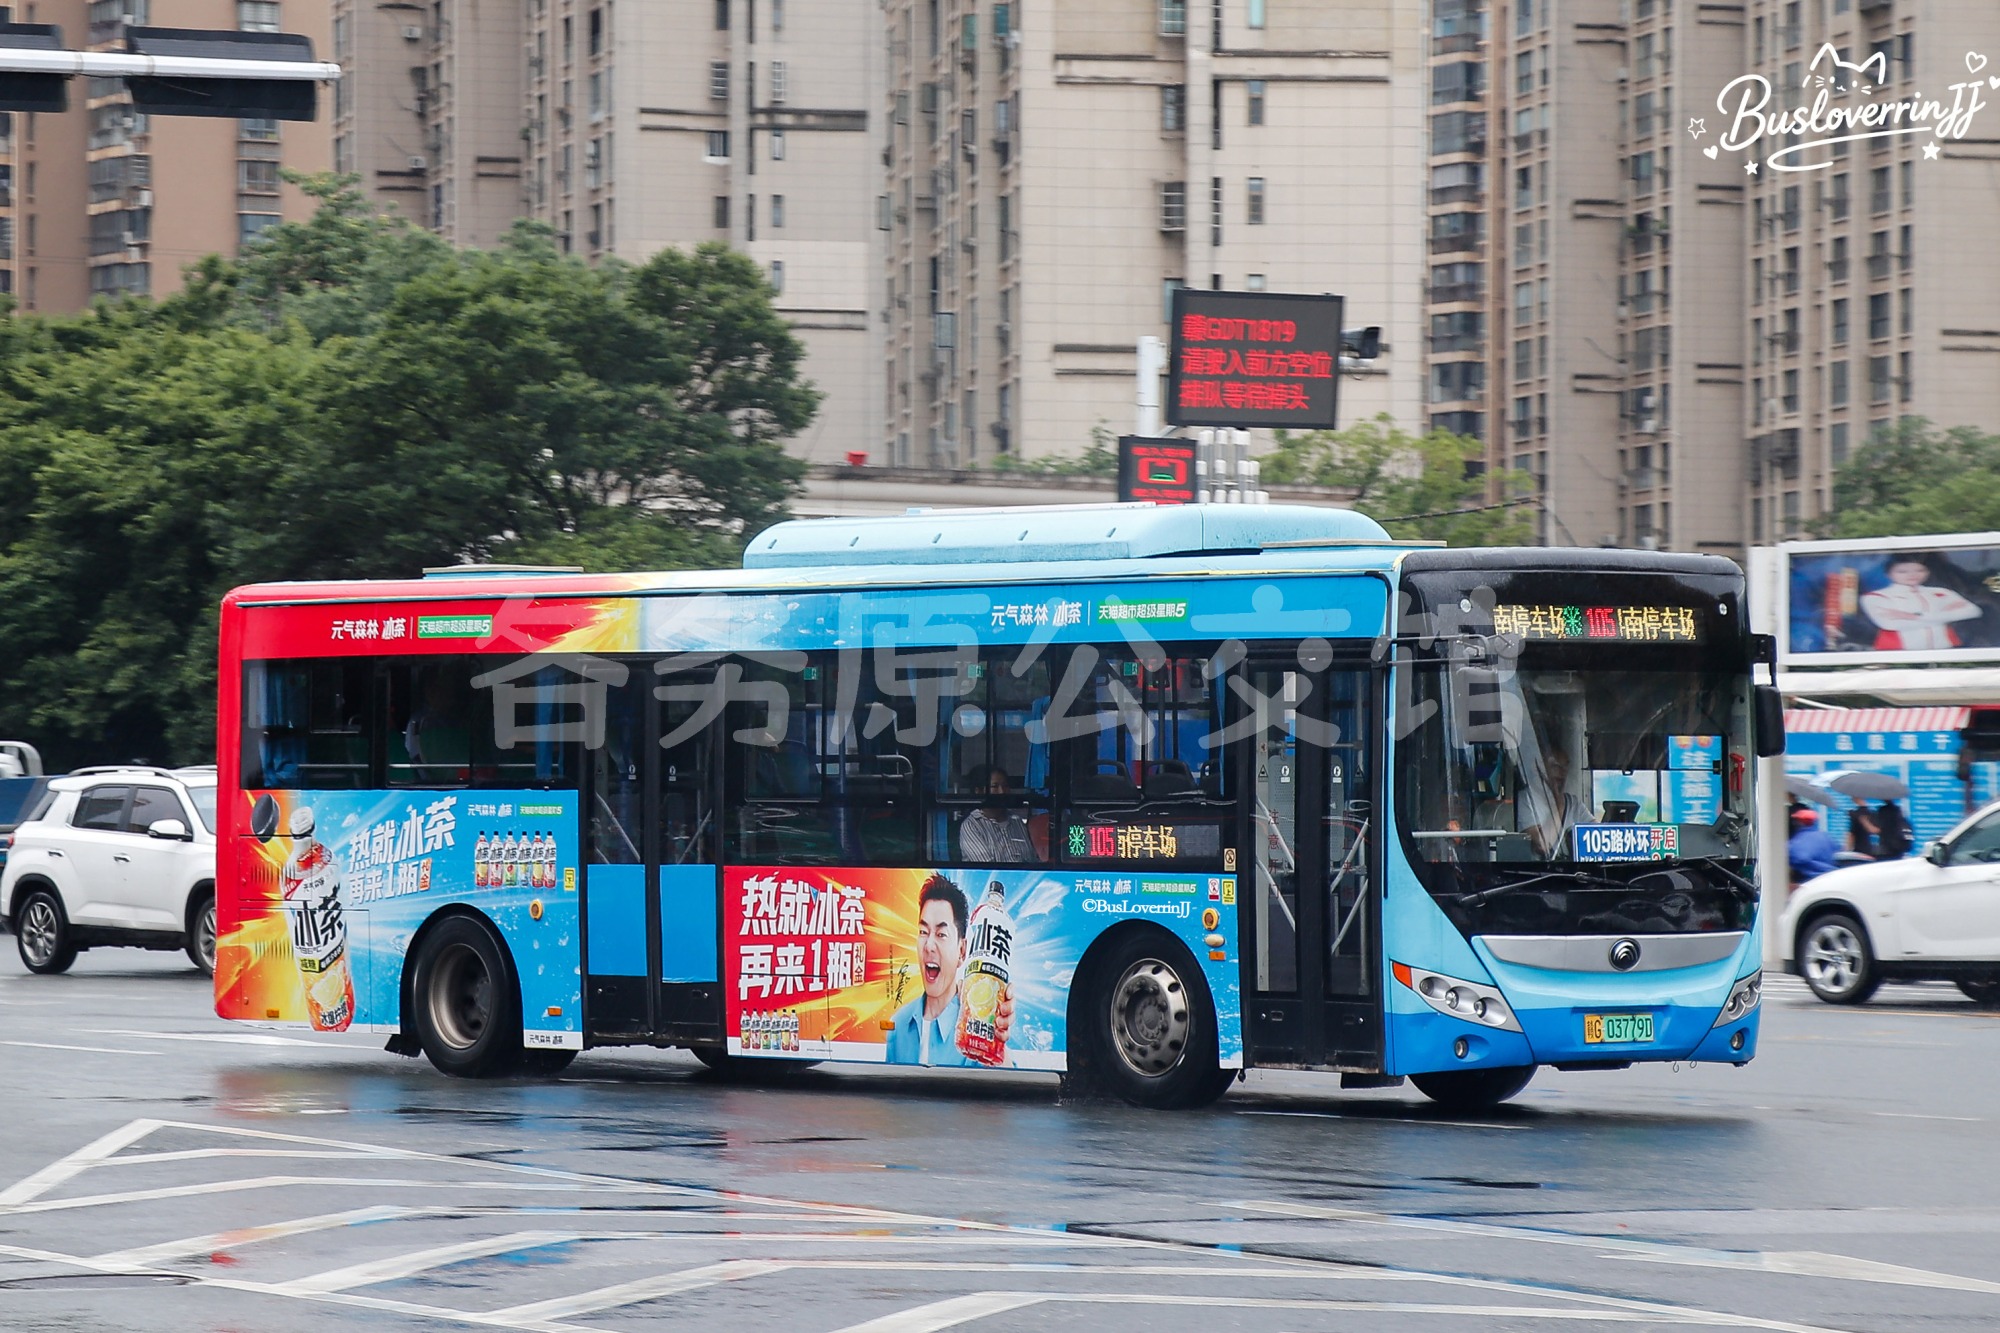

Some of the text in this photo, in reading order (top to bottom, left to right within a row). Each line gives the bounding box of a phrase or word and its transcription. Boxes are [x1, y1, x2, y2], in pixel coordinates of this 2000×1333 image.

[331, 619, 380, 640] 元气森林
[991, 601, 1187, 627] 元气森林 冰茶 天猫超市超级星期5
[1586, 608, 1617, 637] 105
[1617, 606, 1697, 640] 南停车场
[348, 796, 458, 874] 热就冰茶
[1088, 827, 1116, 857] 105
[1583, 828, 1650, 854] 105路外环
[1650, 826, 1677, 850] 开启
[349, 861, 419, 906] 再来1瓶
[1074, 879, 1111, 894] 元气森林
[294, 883, 344, 947] 冰茶
[739, 871, 866, 936] 热就冰茶
[969, 918, 1012, 966] 冰茶
[738, 939, 853, 1001] 再来1瓶
[854, 945, 866, 984] 礼金
